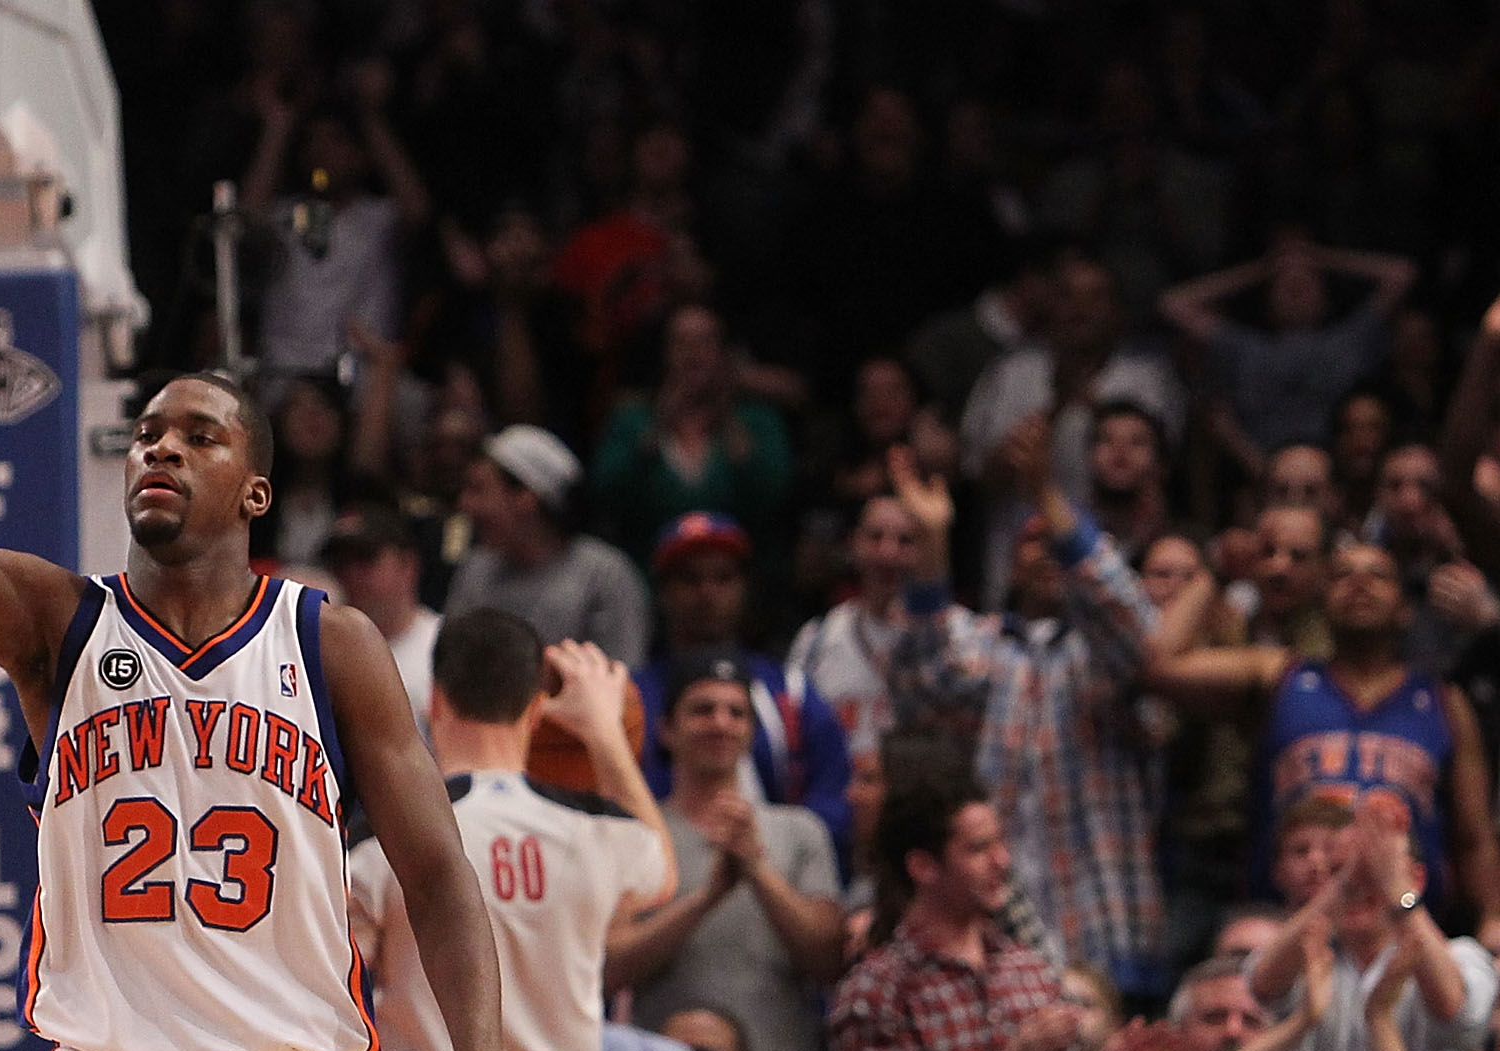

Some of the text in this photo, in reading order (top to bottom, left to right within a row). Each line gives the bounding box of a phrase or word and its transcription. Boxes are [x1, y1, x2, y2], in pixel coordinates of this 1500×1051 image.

[108, 657, 134, 678] 15
[53, 695, 335, 829] NEW YORK
[101, 796, 279, 933] 23
[490, 835, 546, 903] 60
